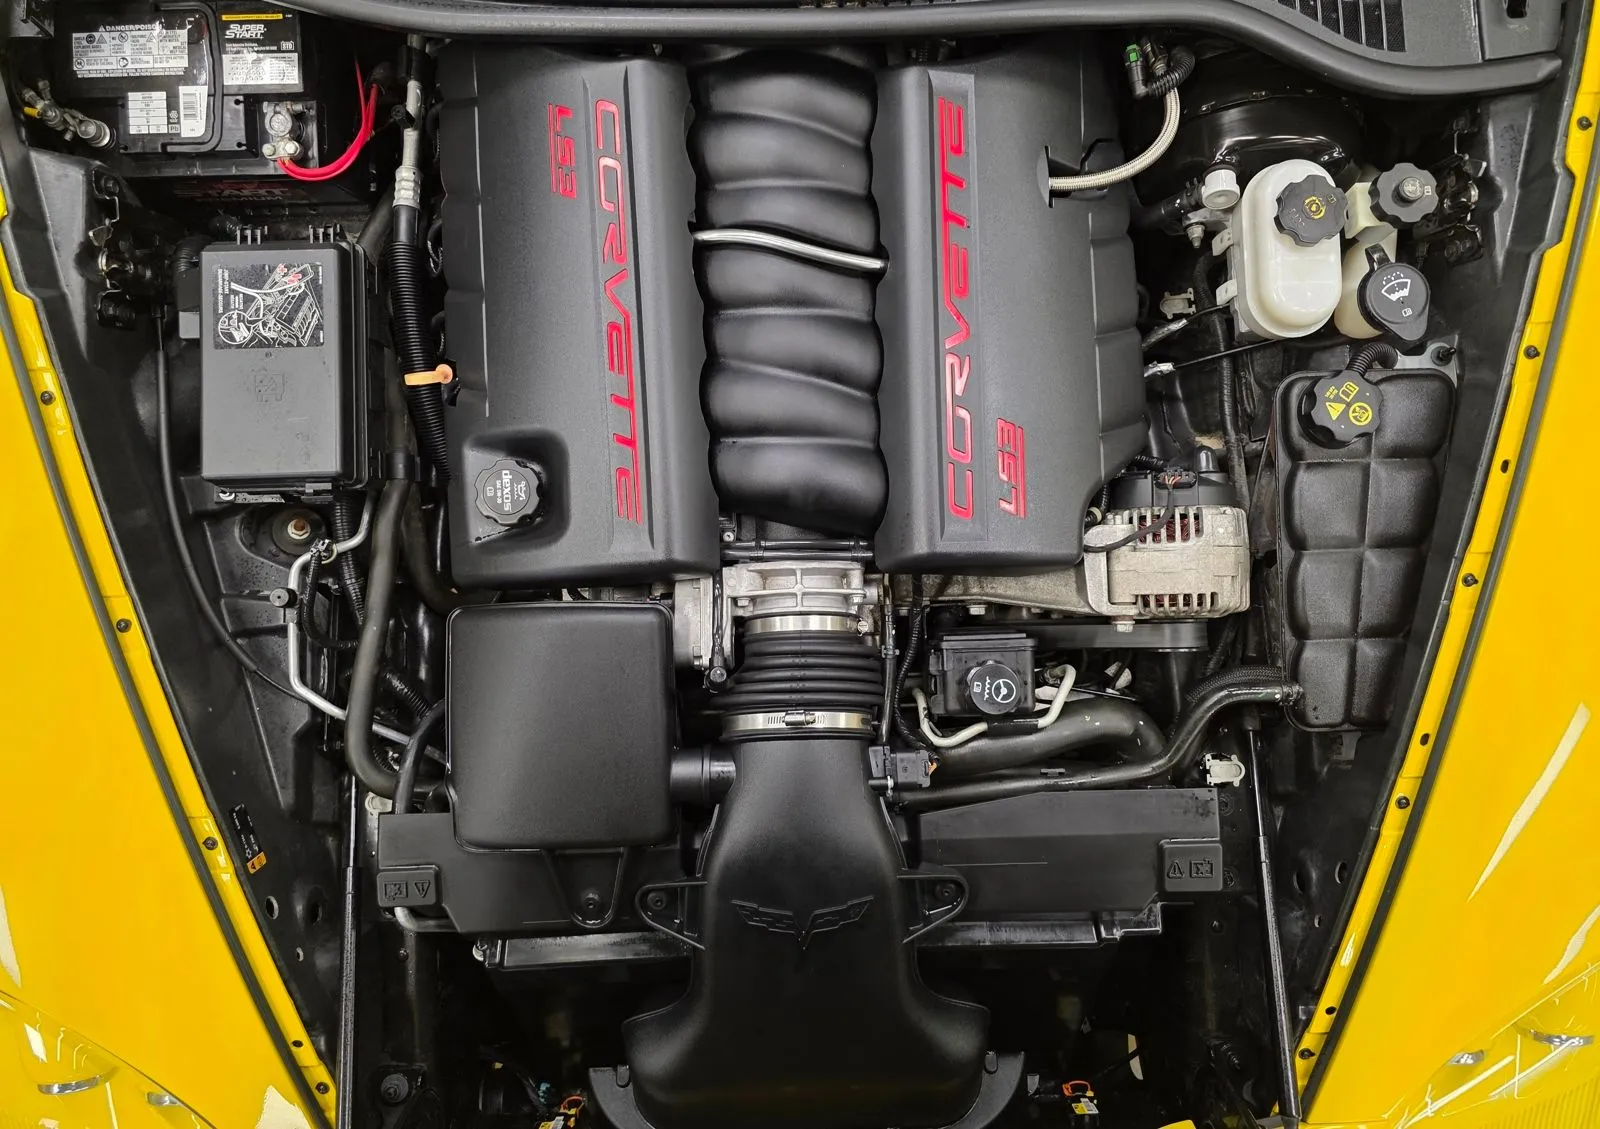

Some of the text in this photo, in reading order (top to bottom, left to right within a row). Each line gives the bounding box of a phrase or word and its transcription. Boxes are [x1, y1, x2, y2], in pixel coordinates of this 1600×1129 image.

[224, 30, 264, 39] START
[229, 23, 265, 32] SUPER
[554, 104, 577, 199] LS3
[595, 99, 644, 525] CORVETTE
[937, 96, 974, 520] CORVETTE
[502, 470, 513, 512] dexos
[996, 417, 1018, 517] LS3
